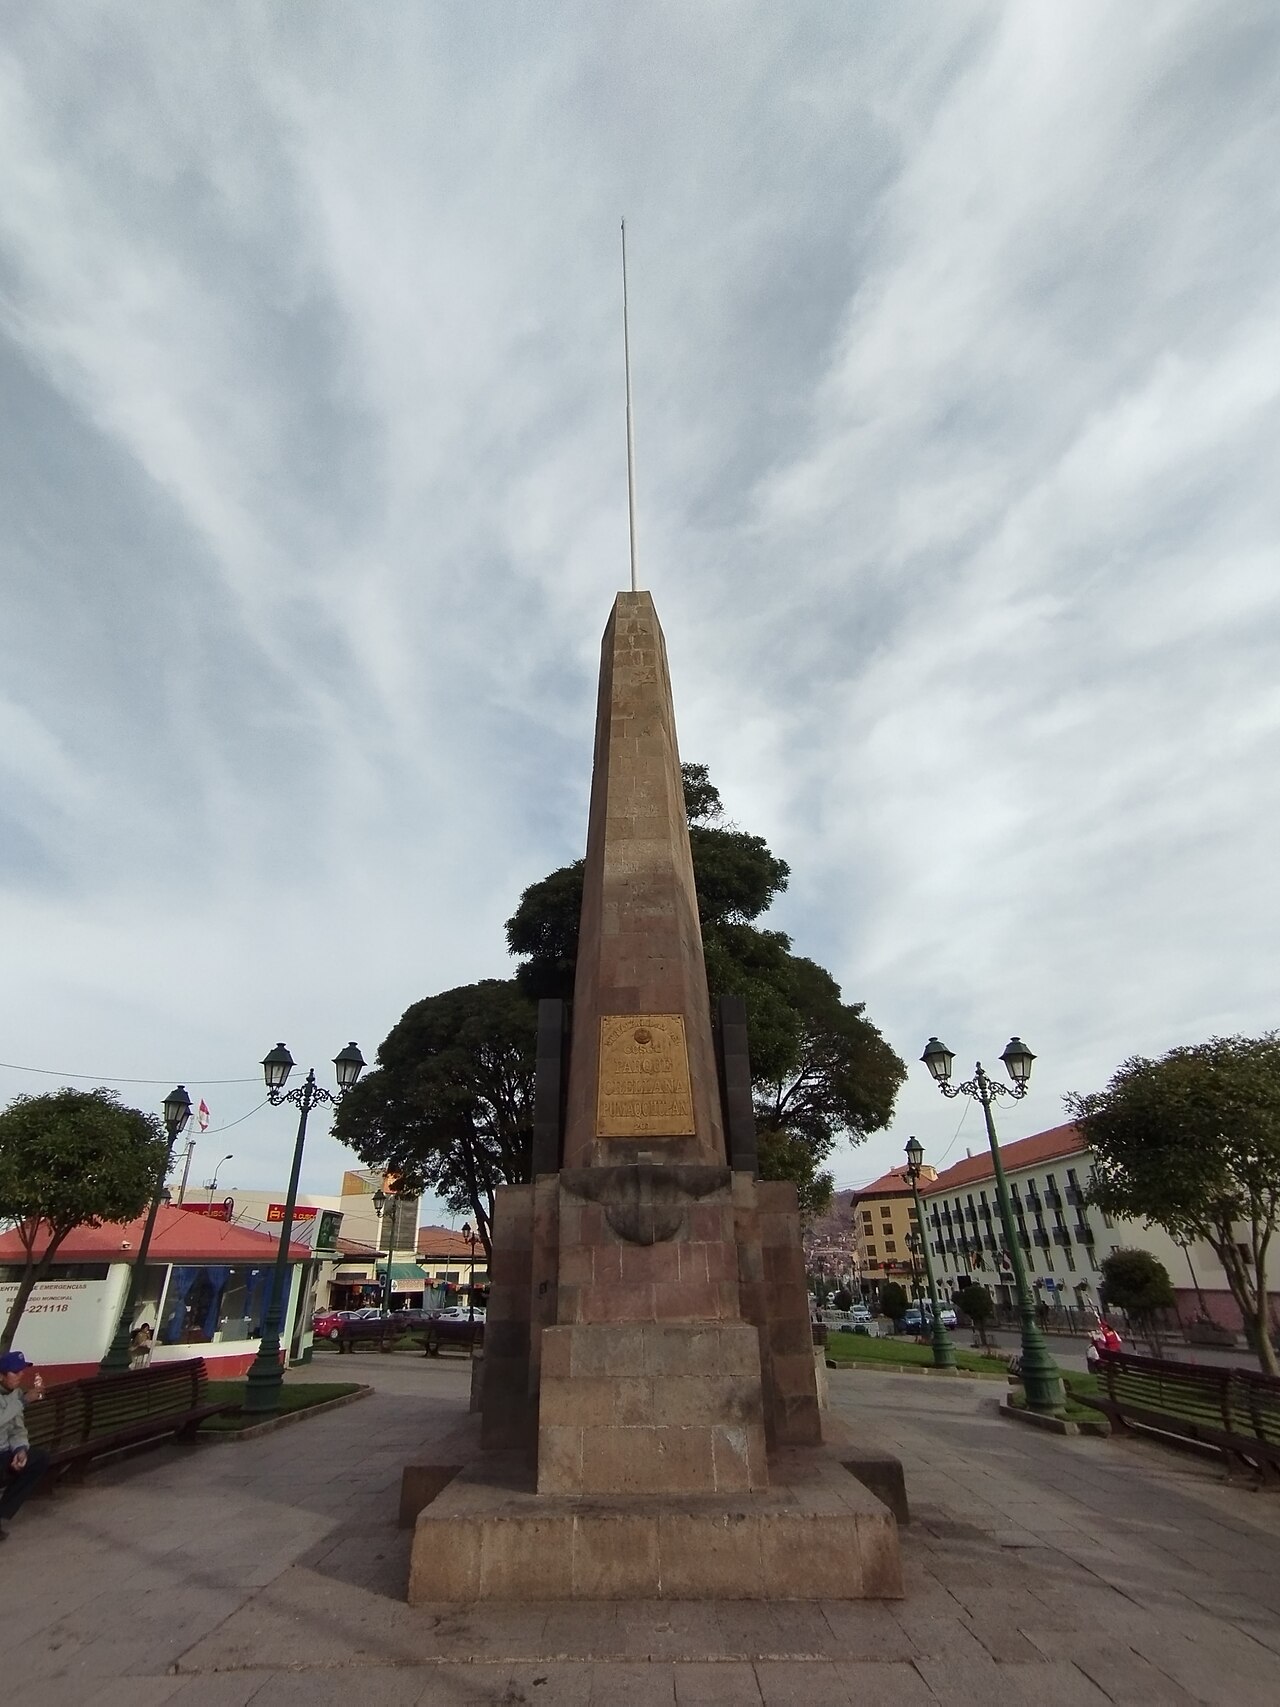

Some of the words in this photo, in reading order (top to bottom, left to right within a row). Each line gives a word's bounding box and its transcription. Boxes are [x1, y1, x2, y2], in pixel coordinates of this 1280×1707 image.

[613, 1057, 673, 1075] PARQUE
[602, 1078, 688, 1096] ORELLANA
[6, 1304, 69, 1314] 0-221118
